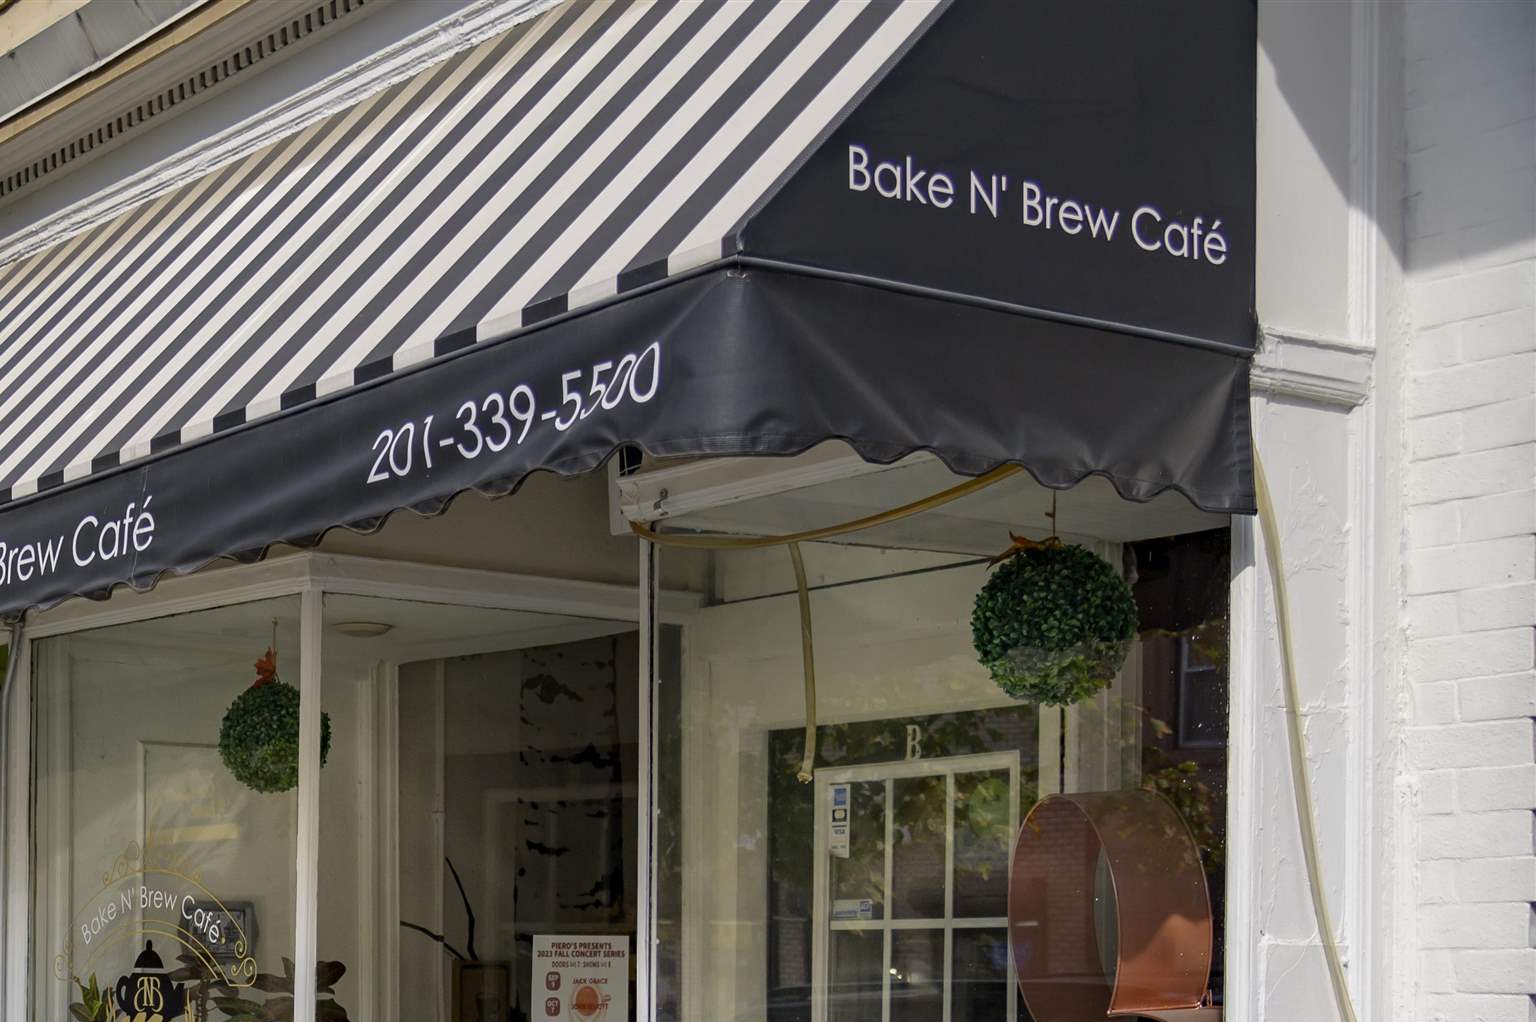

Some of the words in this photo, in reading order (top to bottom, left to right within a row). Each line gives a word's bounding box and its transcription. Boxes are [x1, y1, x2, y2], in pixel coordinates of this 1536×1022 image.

[848, 144, 955, 209] Bake
[970, 170, 1007, 219] N'
[1022, 181, 1120, 241] Brew
[1131, 206, 1227, 265] Café
[366, 341, 660, 484] 201-339-5500
[72, 495, 155, 567] Café
[81, 902, 116, 945] Bake
[120, 888, 135, 914] N'
[140, 886, 178, 911] Brew
[181, 895, 220, 943] Café
[579, 942, 612, 950] PRESENTS
[537, 950, 553, 958] 2023
[554, 950, 570, 958] FALL
[571, 950, 602, 958] CONCERT
[603, 950, 625, 958] SERIES
